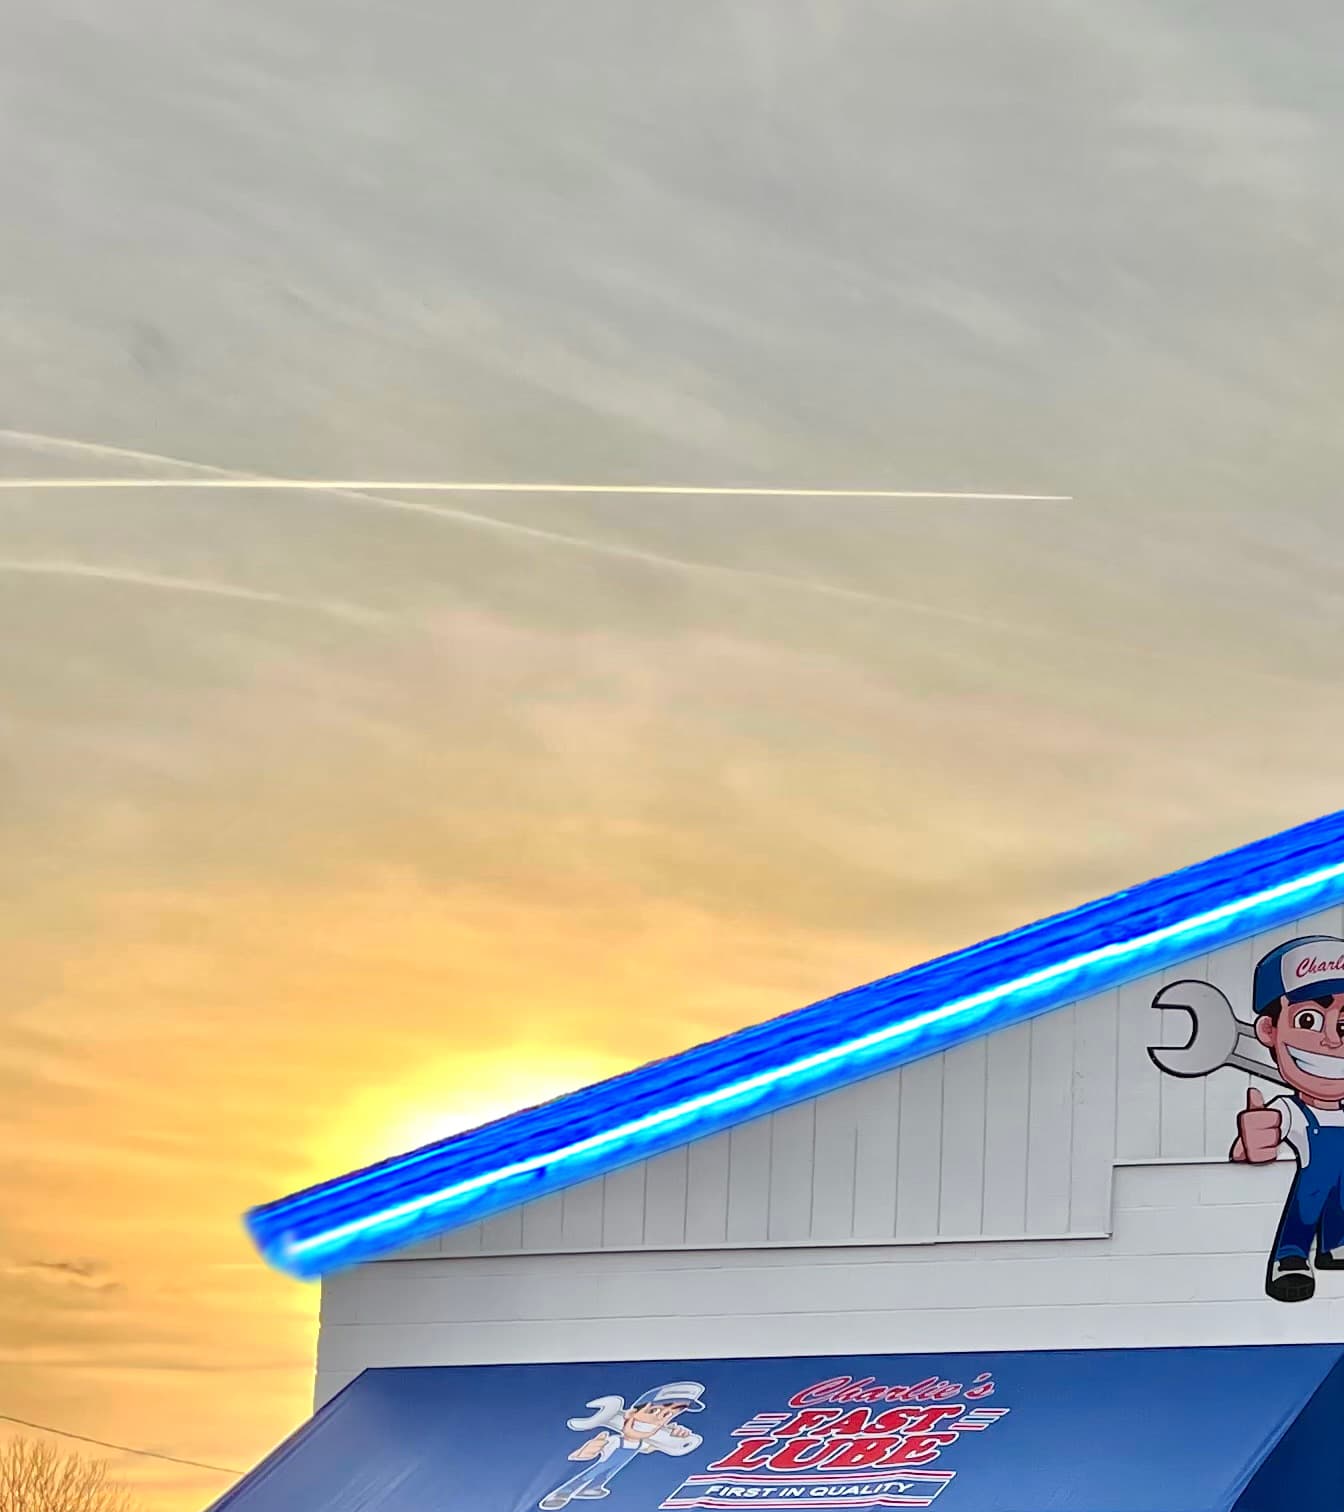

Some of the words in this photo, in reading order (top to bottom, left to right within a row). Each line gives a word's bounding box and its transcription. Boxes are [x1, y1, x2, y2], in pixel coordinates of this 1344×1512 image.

[787, 1372, 996, 1409] Charlie's
[770, 1404, 964, 1439] FAST
[706, 1431, 959, 1473] LUBE
[705, 1484, 777, 1498] FIRST
[778, 1487, 806, 1498] IN
[809, 1481, 916, 1498] QUALITY
